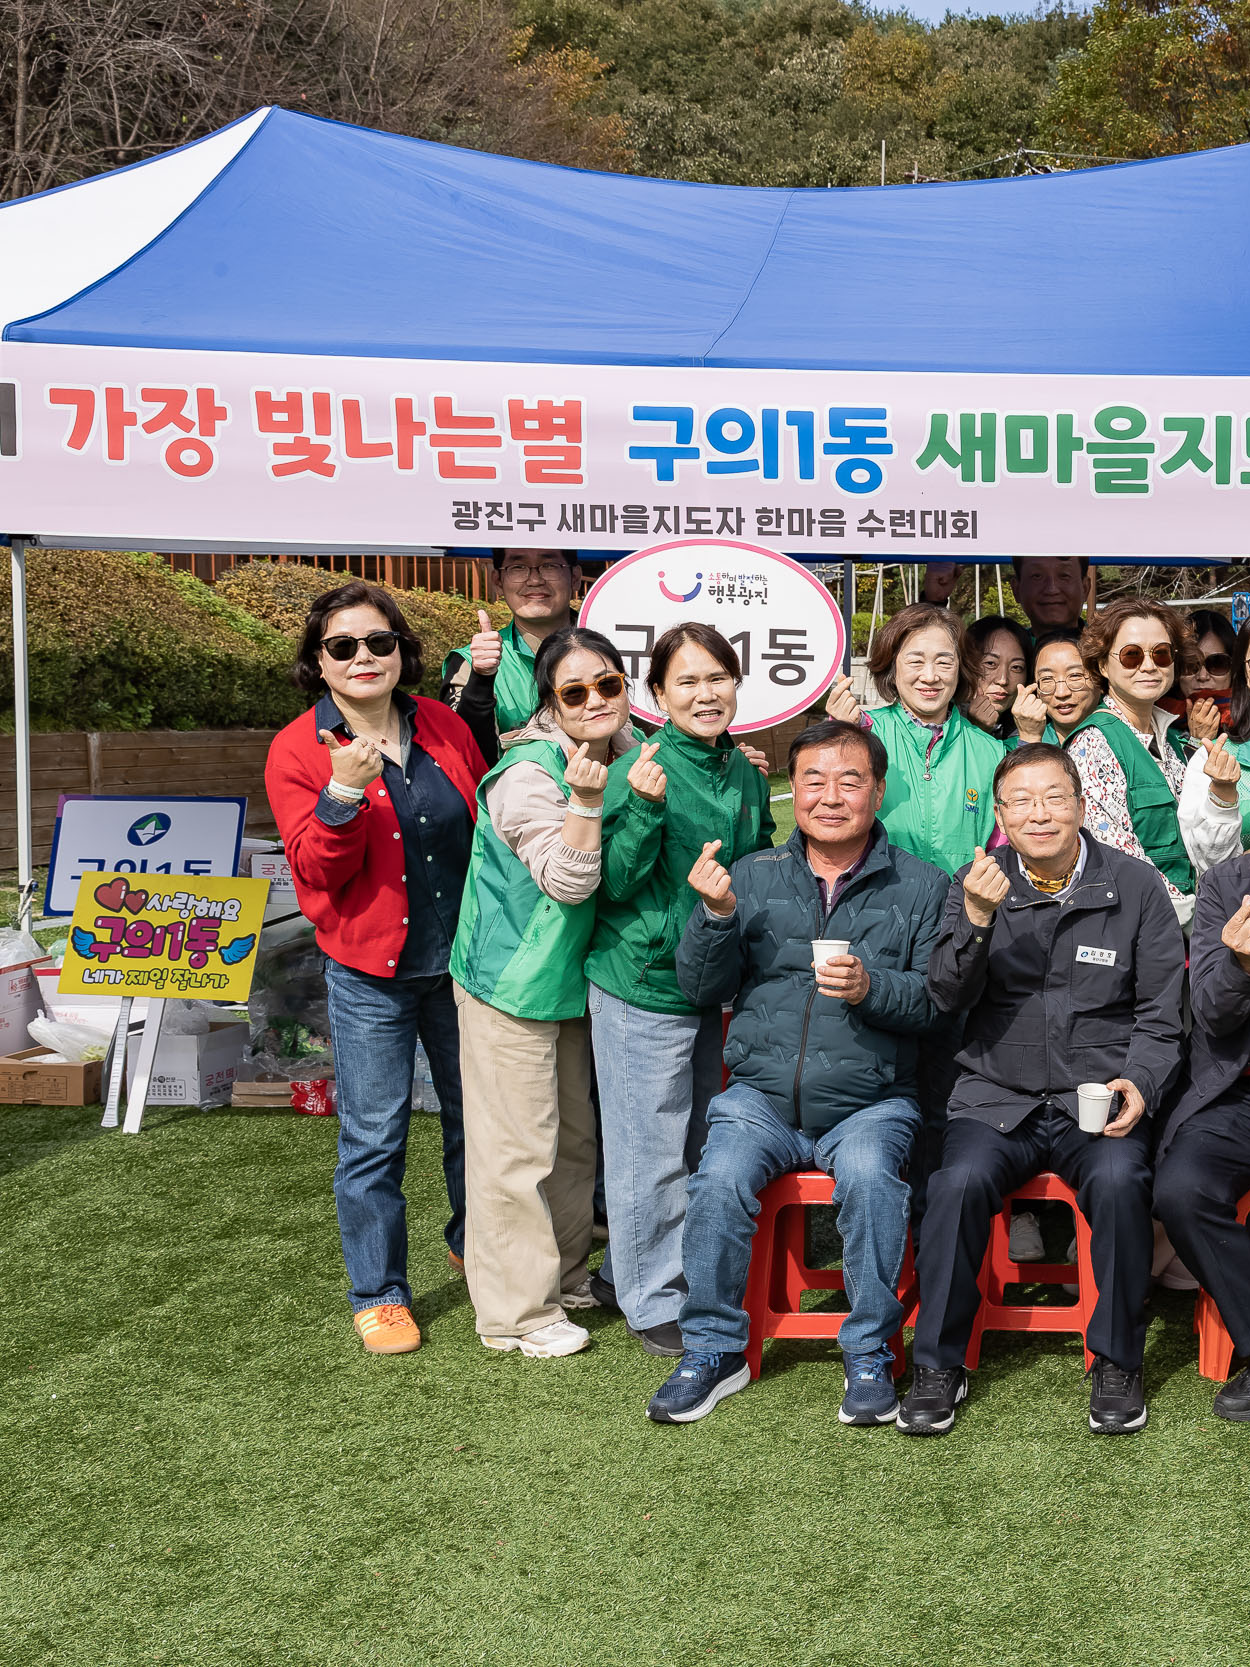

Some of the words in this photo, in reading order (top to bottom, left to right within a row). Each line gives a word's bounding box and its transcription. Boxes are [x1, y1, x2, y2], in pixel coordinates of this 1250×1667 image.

[49, 386, 228, 478] 가장
[253, 390, 584, 485] 빛나는별
[628, 405, 894, 495] 구의1동
[451, 500, 547, 532] 광진구
[556, 503, 746, 536] 새마을지도자
[755, 506, 847, 538] 한마음
[856, 509, 979, 540] 수련대회
[707, 583, 768, 606] 행복광진
[615, 623, 815, 687] 구1동
[145, 892, 242, 921] 사랑해요
[89, 916, 223, 969] 구의1동
[82, 968, 124, 985] 네가
[125, 968, 169, 991] 제일
[170, 969, 230, 992] 잘나가
